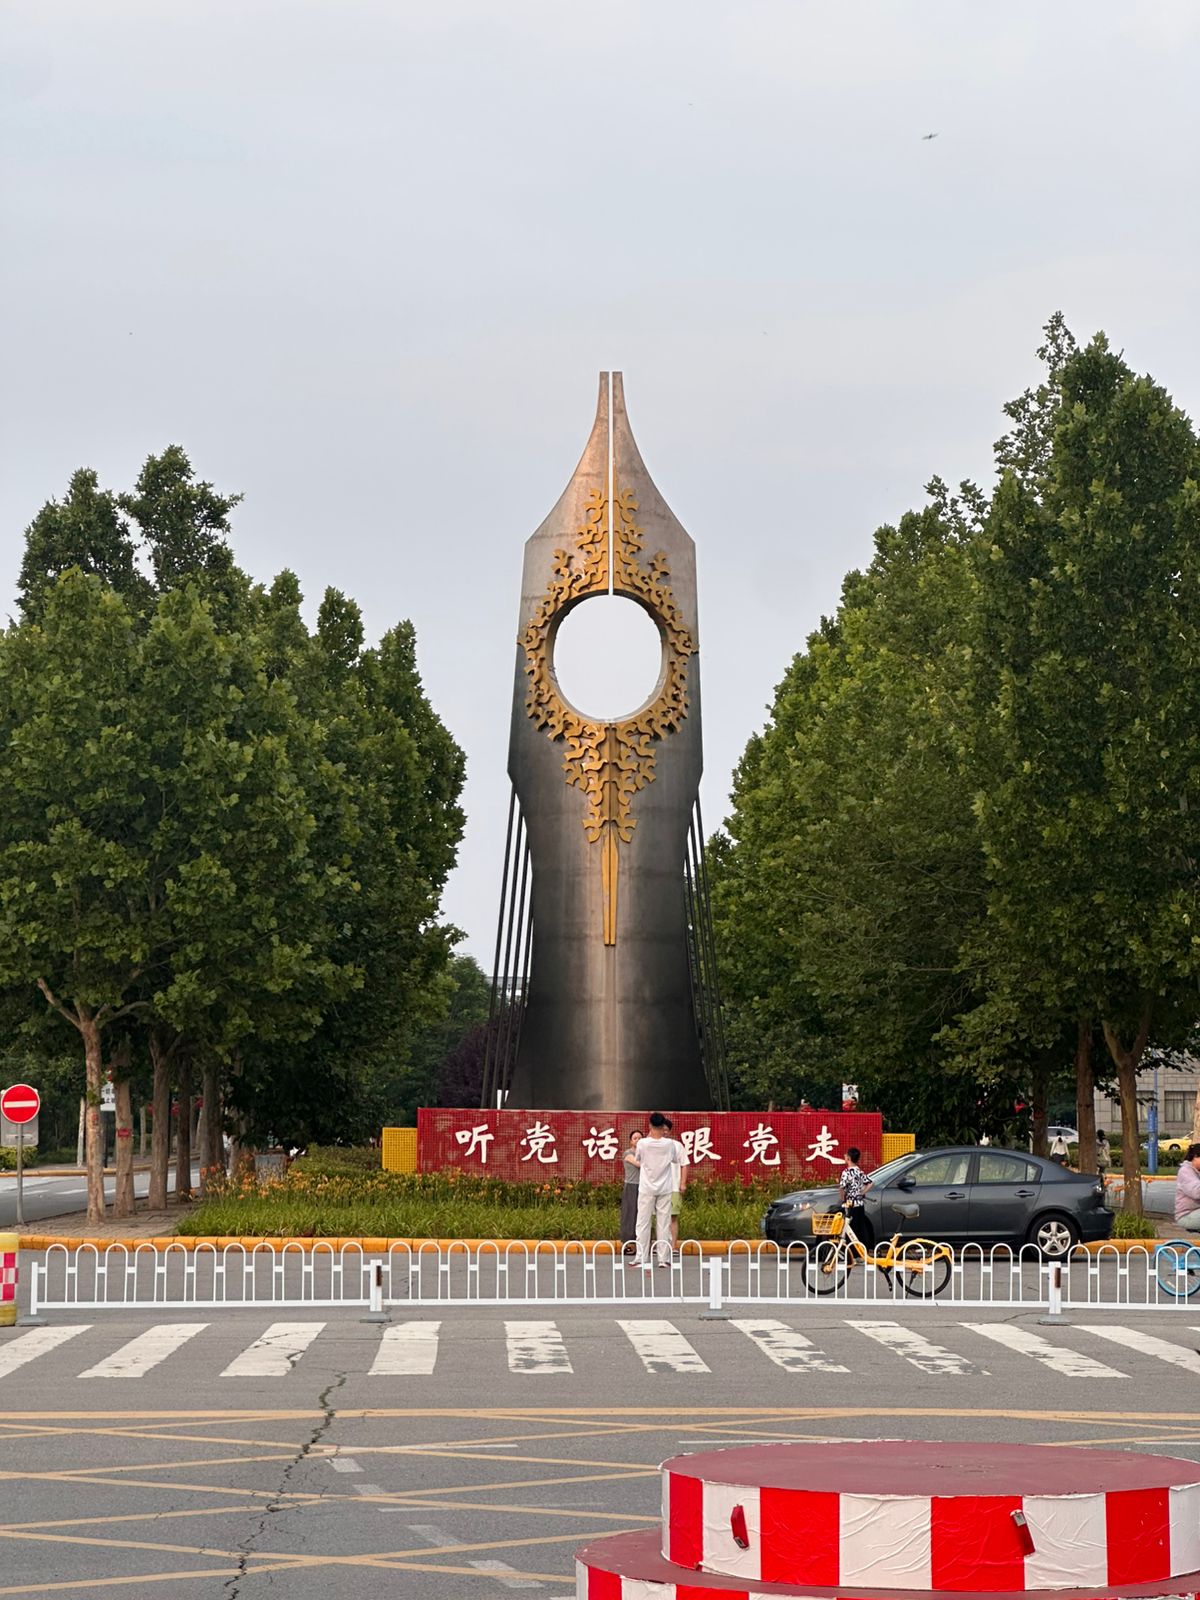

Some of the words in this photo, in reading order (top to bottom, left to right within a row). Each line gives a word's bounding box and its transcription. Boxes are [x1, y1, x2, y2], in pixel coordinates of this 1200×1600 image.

[455, 1121, 618, 1163] 听党话
[680, 1123, 846, 1165] 跟党走
